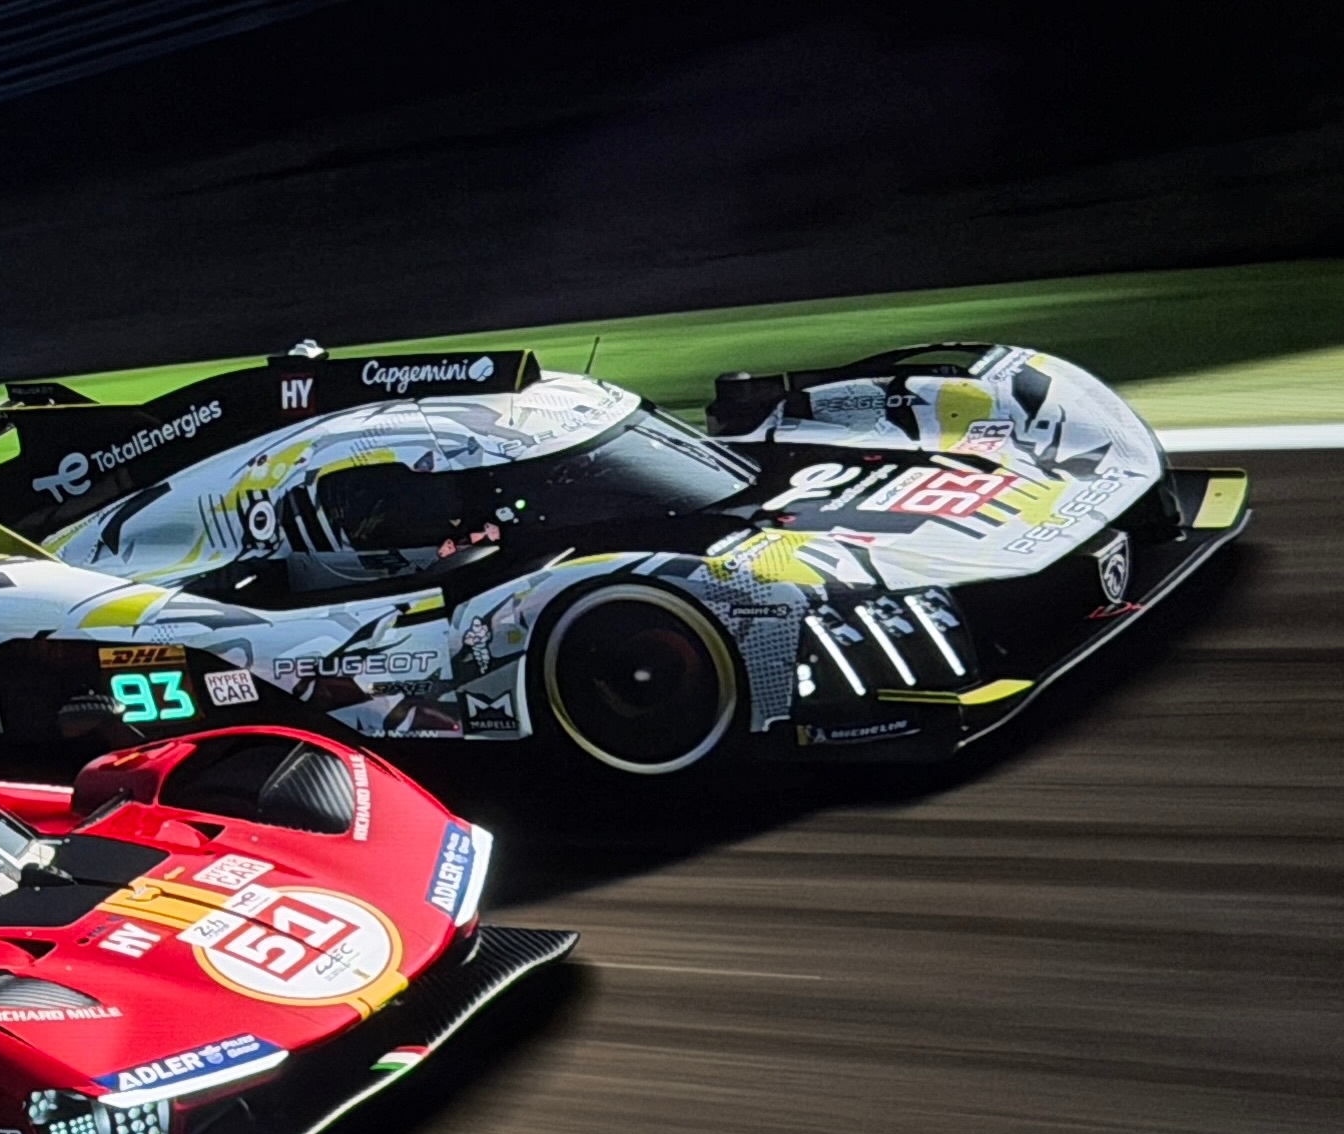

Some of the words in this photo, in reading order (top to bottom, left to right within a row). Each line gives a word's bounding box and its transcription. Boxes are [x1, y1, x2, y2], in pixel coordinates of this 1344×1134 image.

[281, 378, 313, 410] HY
[362, 358, 469, 394] Capgemini
[90, 400, 222, 473] TotalEnergies
[900, 471, 1006, 514] 93
[1004, 467, 1127, 555] PEUGEOT
[112, 648, 172, 665] DHL
[273, 651, 438, 680] PEUGEOT
[110, 670, 195, 723] 93
[207, 672, 249, 686] HYPER
[213, 684, 255, 703] CAR
[469, 719, 517, 730] MARELLI
[352, 788, 370, 841] RICHARD
[216, 861, 266, 886] CAR
[431, 862, 465, 912] ADLER
[98, 922, 162, 959] HY
[223, 905, 348, 975] 51
[66, 1005, 123, 1020] MILLE
[118, 1051, 205, 1092] ADLER
